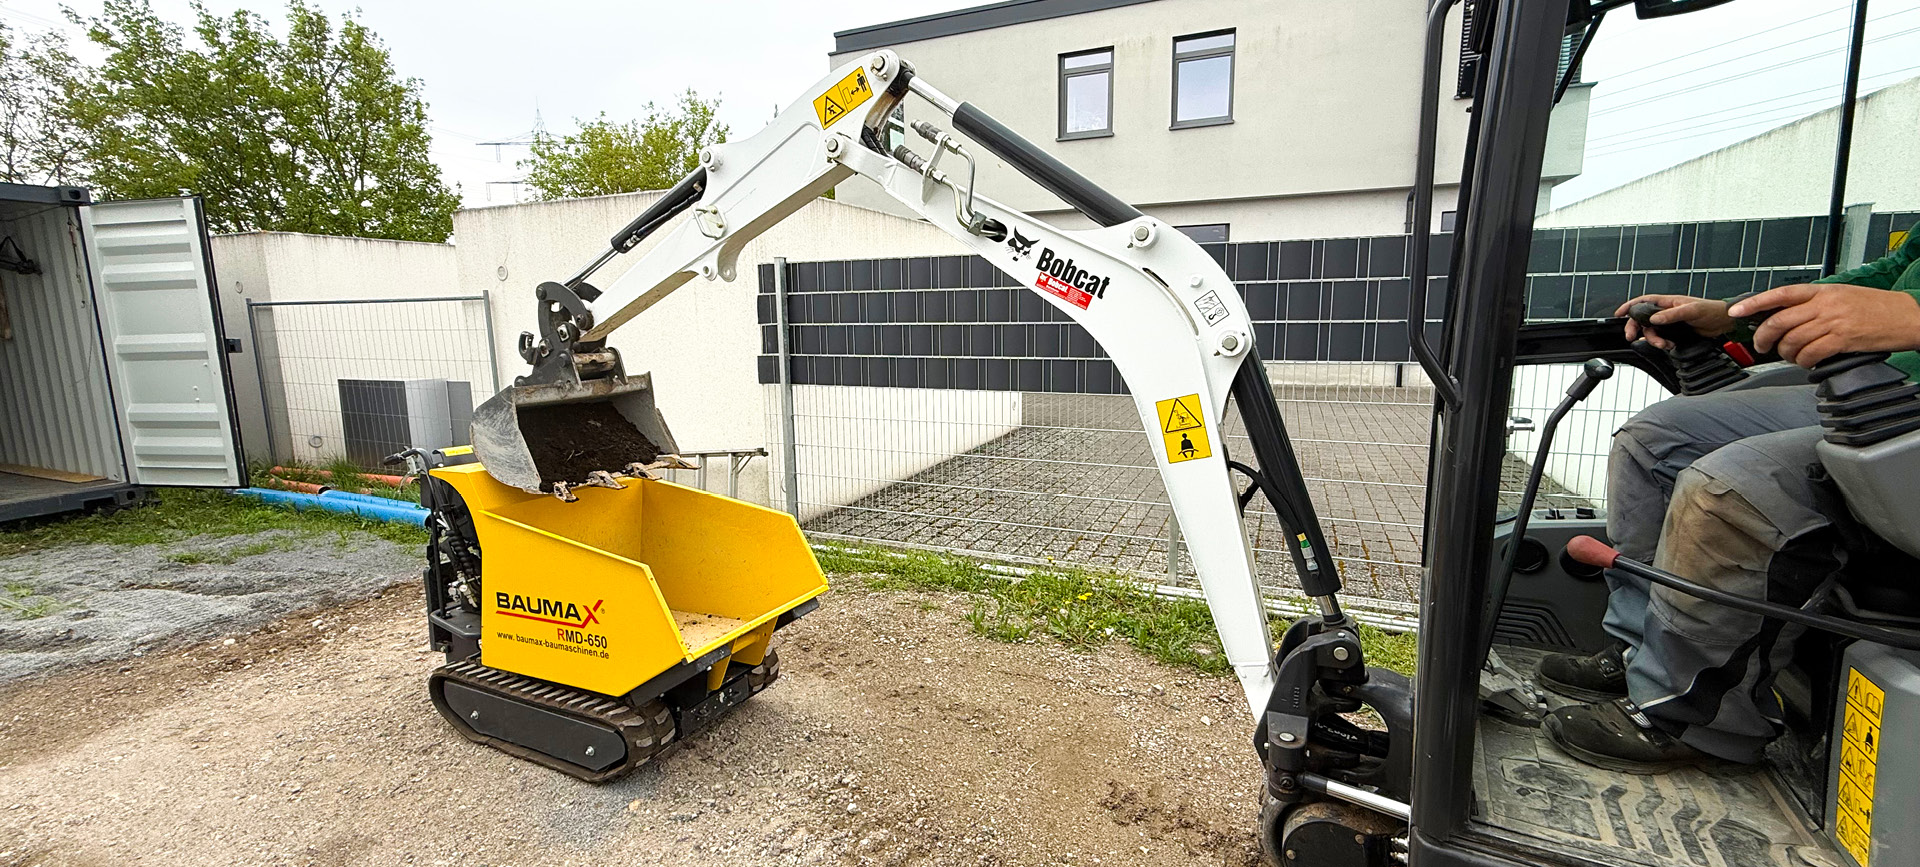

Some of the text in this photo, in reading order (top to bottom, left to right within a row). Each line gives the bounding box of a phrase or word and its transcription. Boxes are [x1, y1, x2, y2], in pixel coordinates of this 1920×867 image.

[1036, 247, 1110, 299] Bobcat
[496, 592, 604, 626] BAUMAX
[557, 628, 608, 649] RMD-650
